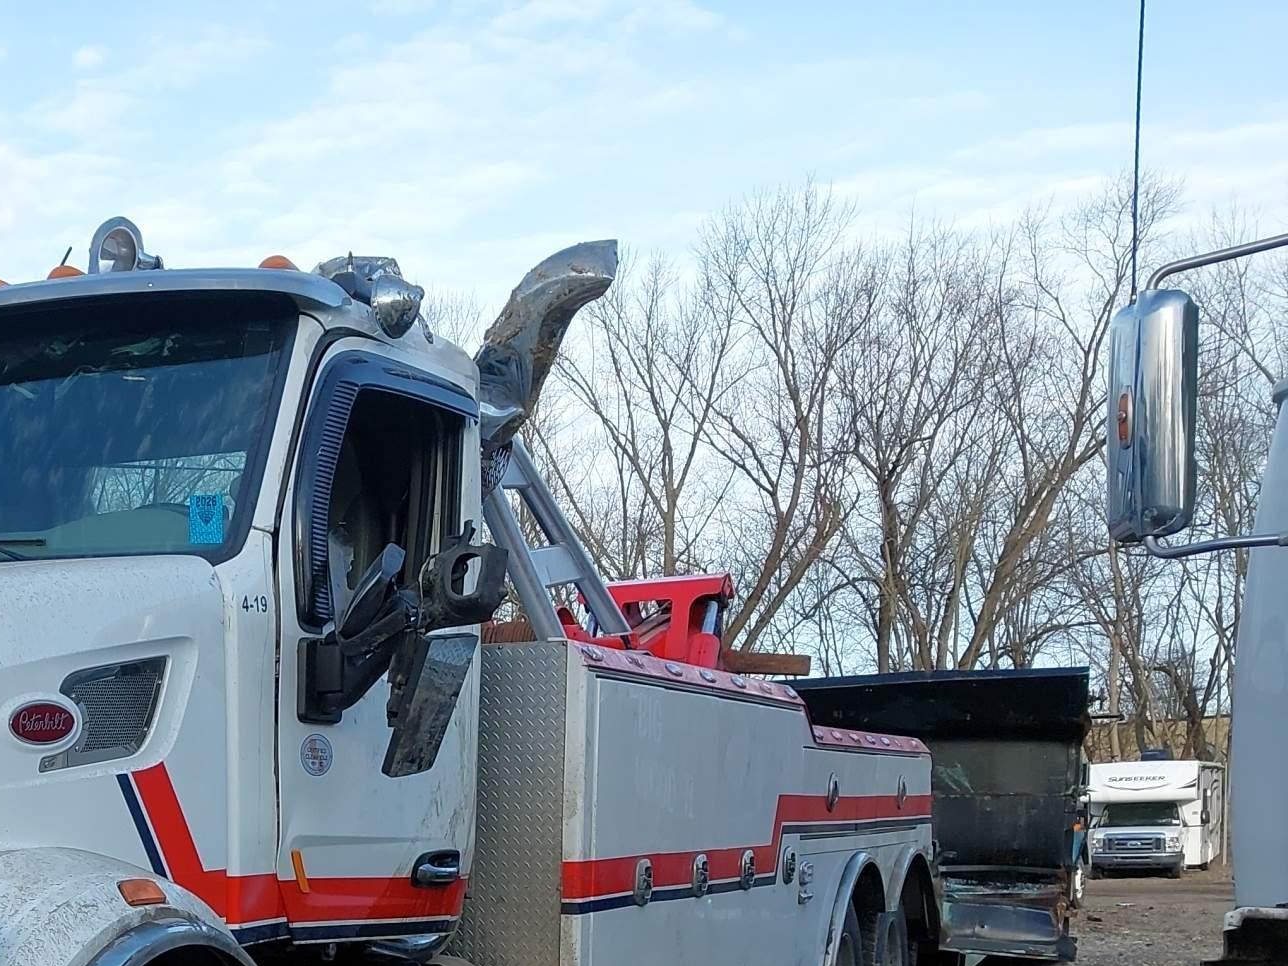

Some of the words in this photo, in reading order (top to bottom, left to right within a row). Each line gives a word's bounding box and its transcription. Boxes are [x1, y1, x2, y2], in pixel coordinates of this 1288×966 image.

[196, 495, 217, 507] 2026
[242, 594, 267, 613] 4-19
[19, 710, 70, 733] Peterbilt
